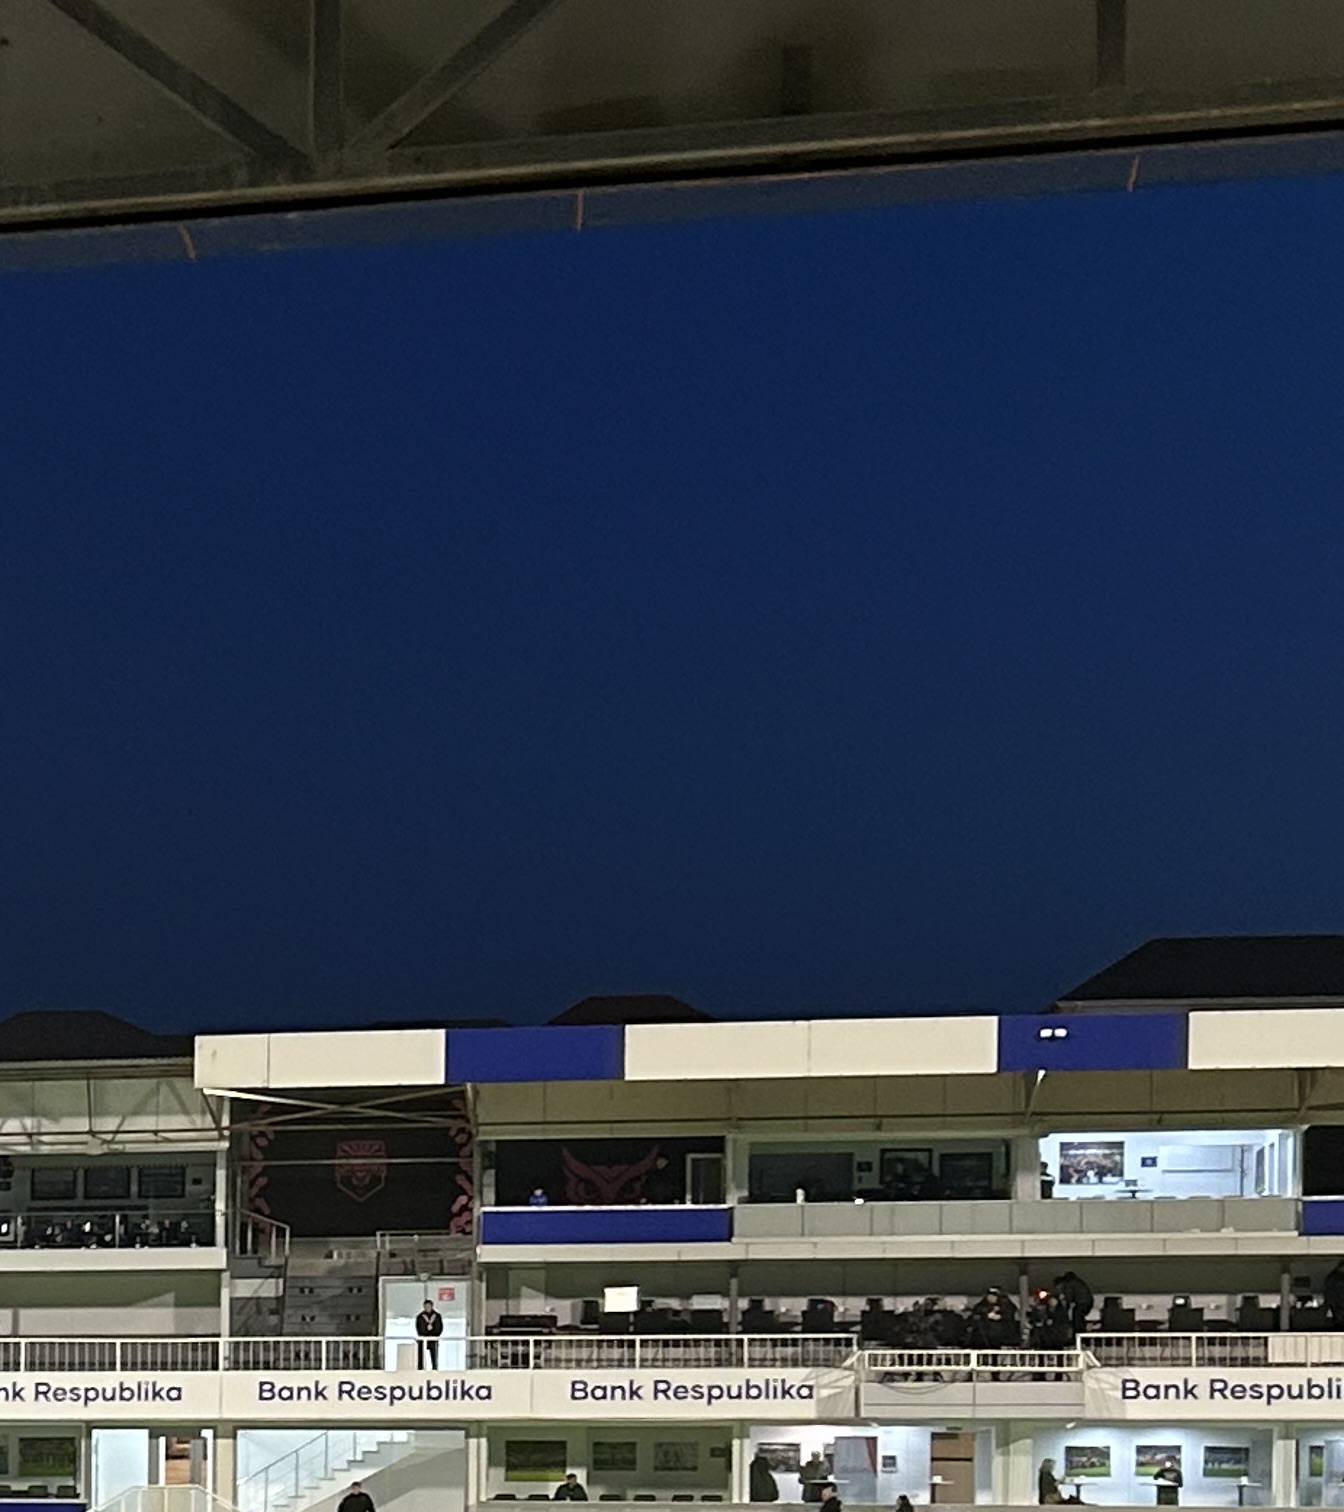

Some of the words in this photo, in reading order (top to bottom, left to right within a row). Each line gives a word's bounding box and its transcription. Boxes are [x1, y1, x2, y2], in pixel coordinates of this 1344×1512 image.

[35, 1382, 182, 1407] Respublika
[259, 1380, 327, 1401] Bank
[338, 1380, 492, 1406] Respublika
[570, 1380, 643, 1400] Bank
[654, 1379, 814, 1405] Respublika
[1121, 1378, 1198, 1400] Bank
[1209, 1377, 1342, 1405] Respubli
